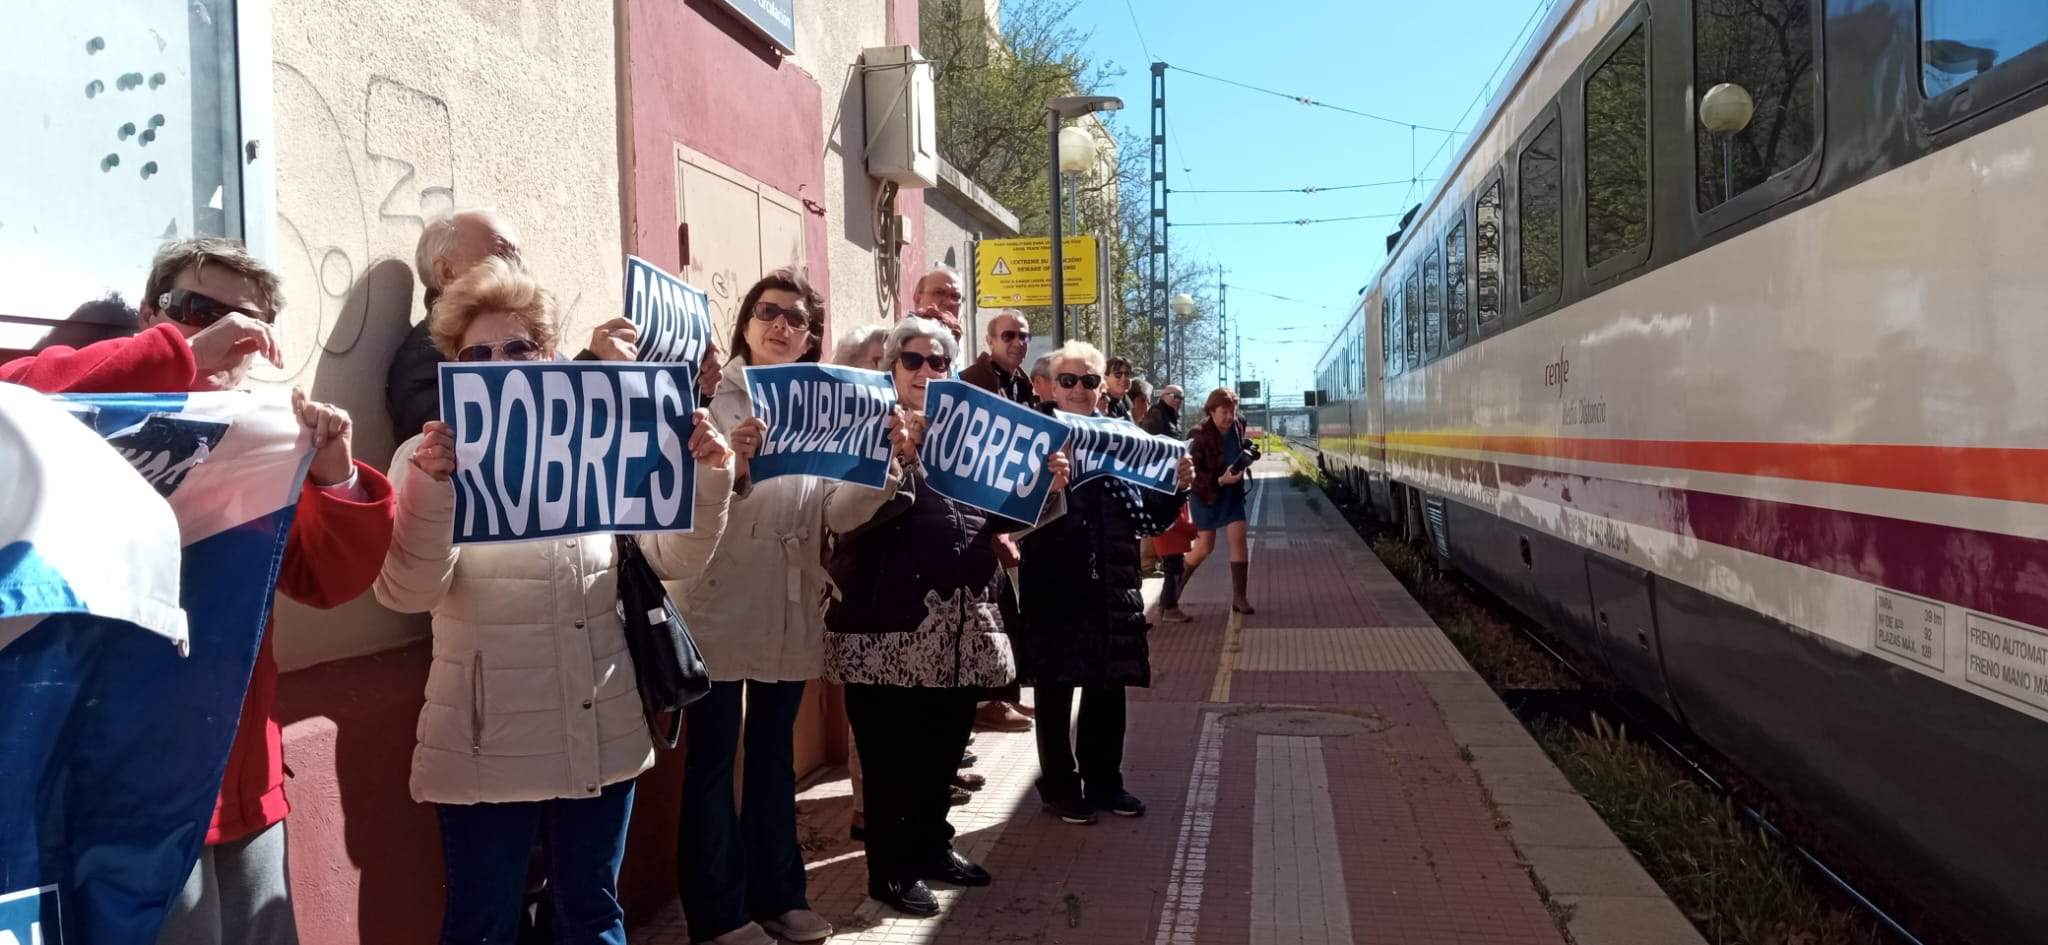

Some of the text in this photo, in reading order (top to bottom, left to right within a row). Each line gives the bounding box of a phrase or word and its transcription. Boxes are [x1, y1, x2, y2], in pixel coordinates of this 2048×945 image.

[1545, 345, 1569, 399] renfe
[756, 378, 896, 462] ALCUBIERRE
[1579, 395, 1606, 425] Distancia
[452, 368, 685, 537] ROBRES
[921, 393, 1050, 499] ROBRES
[1885, 615, 1894, 629] DE
[1924, 608, 1933, 623] 39
[1878, 628, 1901, 648] PLAZAS
[1923, 627, 1933, 641] 92
[1970, 627, 2048, 665] FRENO AUTOMAT
[1969, 654, 2000, 679] FRENO
[2002, 665, 2030, 690] MANO
